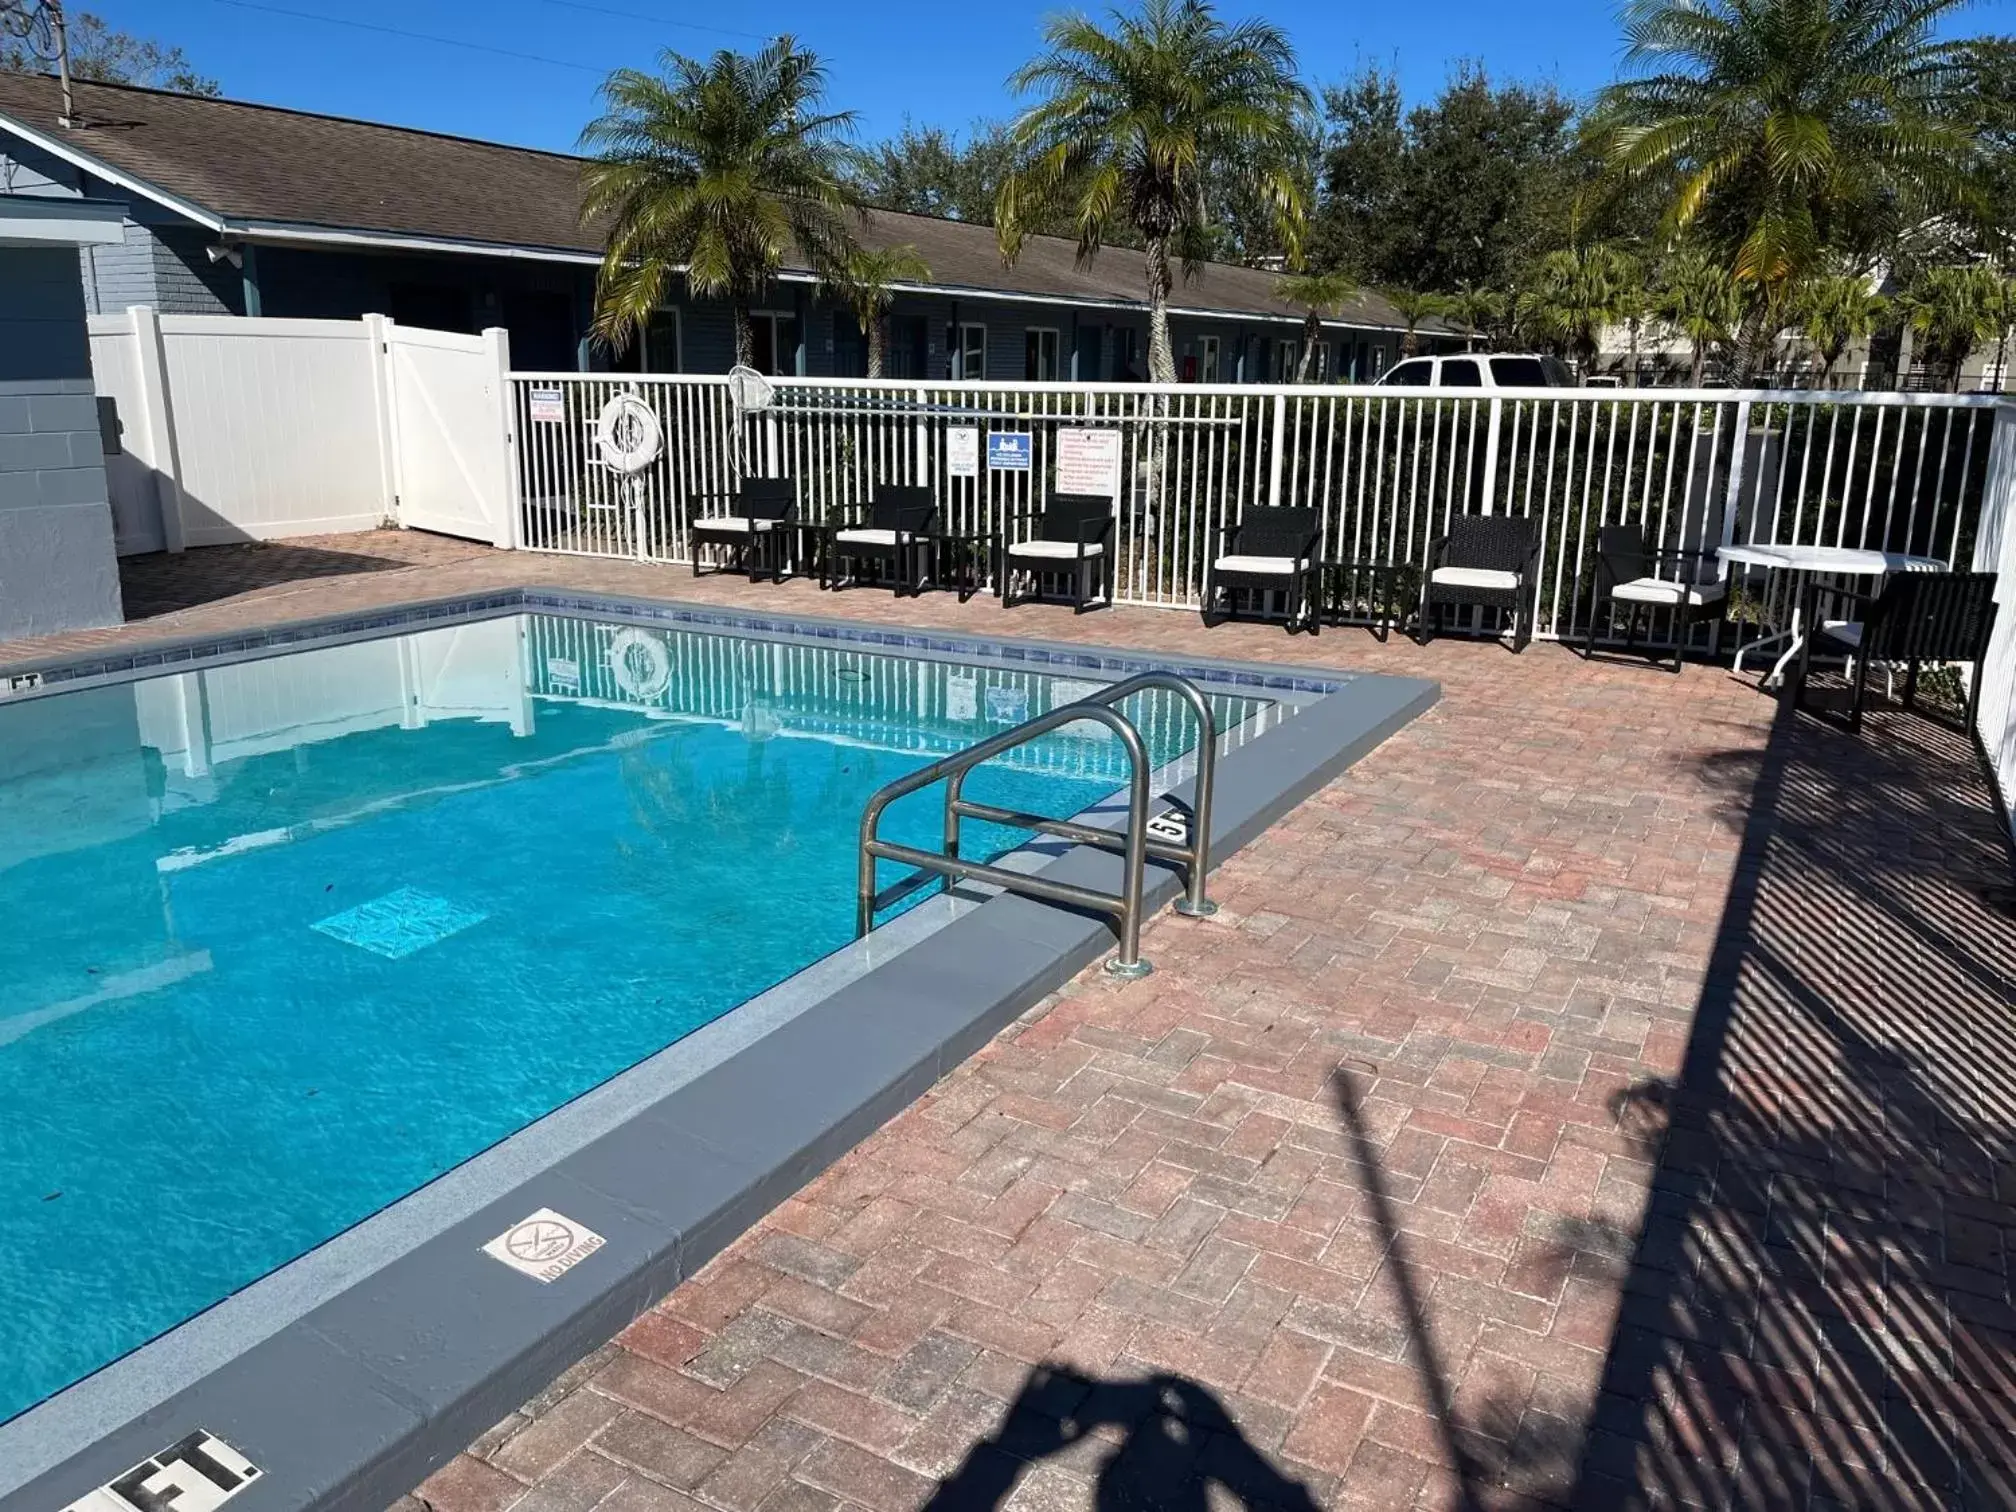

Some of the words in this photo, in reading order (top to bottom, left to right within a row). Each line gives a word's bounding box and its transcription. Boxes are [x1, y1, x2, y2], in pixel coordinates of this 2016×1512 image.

[11, 674, 39, 689] FT
[1149, 821, 1183, 836] 5
[539, 1265, 564, 1280] NO
[556, 1236, 603, 1267] DIVING
